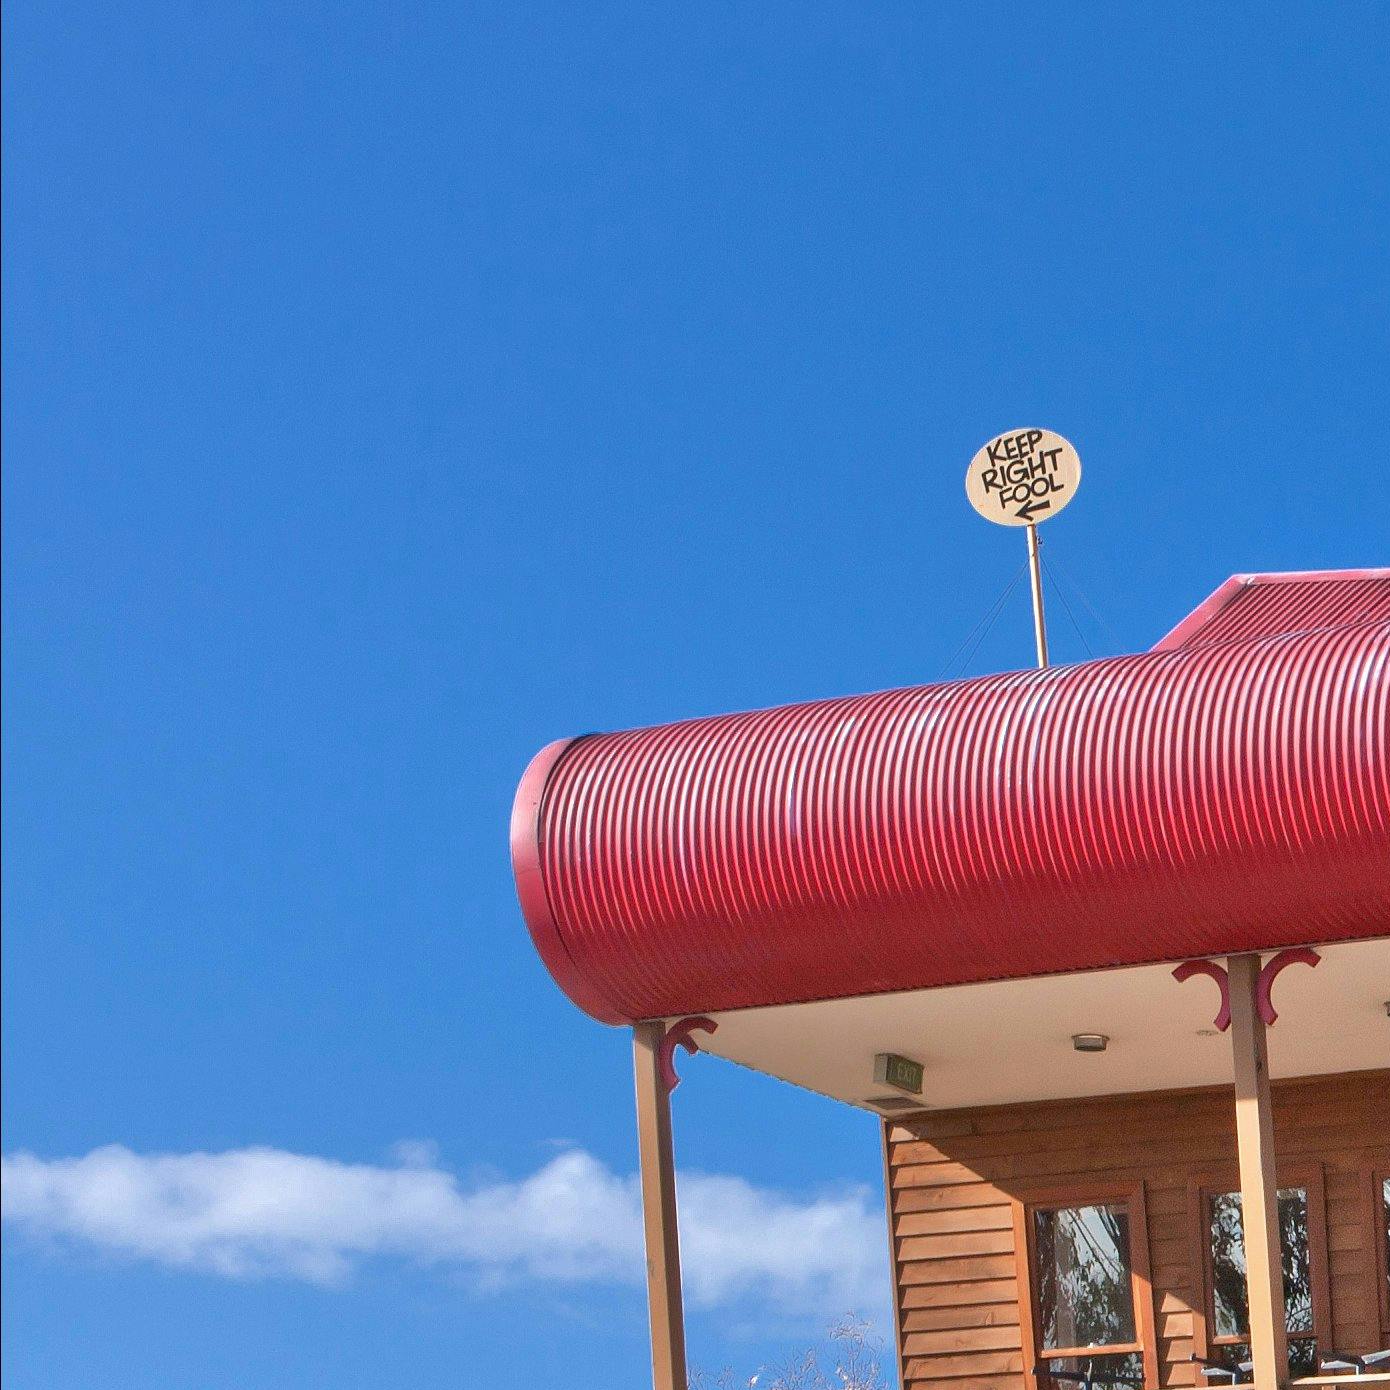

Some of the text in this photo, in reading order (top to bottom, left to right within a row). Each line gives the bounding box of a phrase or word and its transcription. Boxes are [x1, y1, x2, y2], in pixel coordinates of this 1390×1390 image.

[986, 429, 1043, 468] KEEP
[981, 447, 1063, 494] RIGHT
[999, 473, 1065, 510] FOOL
